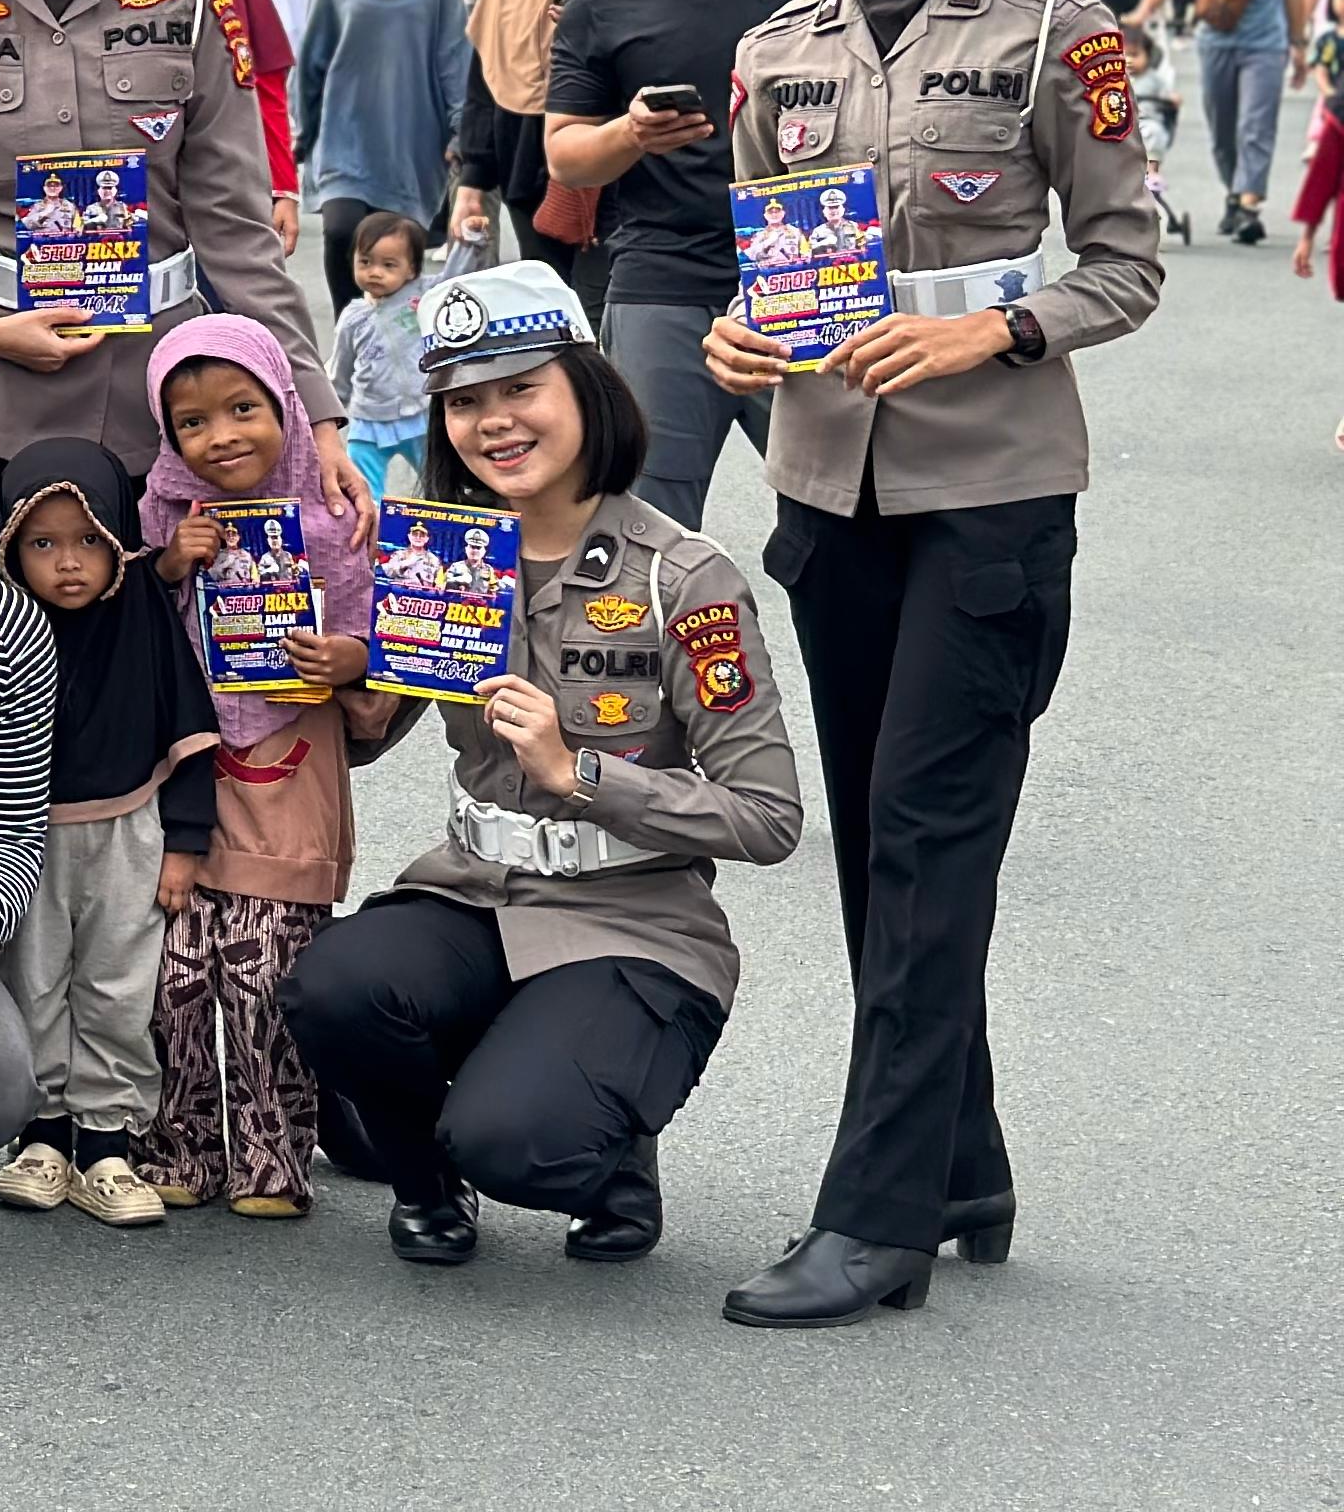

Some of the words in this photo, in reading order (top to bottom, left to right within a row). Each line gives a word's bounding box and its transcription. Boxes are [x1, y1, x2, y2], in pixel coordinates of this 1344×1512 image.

[103, 21, 192, 50] POLRI
[1070, 36, 1119, 64] POLDA
[1087, 61, 1123, 80] RIAU
[920, 70, 1023, 100] POLRI
[40, 244, 86, 262] STOP
[85, 241, 141, 261] HOAX
[85, 262, 122, 273] AMAN
[767, 270, 817, 293] STOP
[817, 261, 878, 287] HOAX
[819, 285, 859, 300] AMAN
[845, 294, 884, 310] DAMAI
[80, 294, 128, 313] HOAX
[760, 319, 798, 333] SARING
[226, 595, 263, 613] STOP
[264, 593, 309, 612] HOAX
[397, 596, 446, 619] STOP
[445, 603, 504, 628] HOAX
[264, 613, 296, 625] AMAN
[676, 607, 734, 636] POLDA
[266, 627, 285, 638] DAN
[442, 624, 482, 639] AMAN
[690, 631, 734, 651] RIAU
[431, 659, 483, 683] HOAX
[559, 648, 659, 677] POLRI
